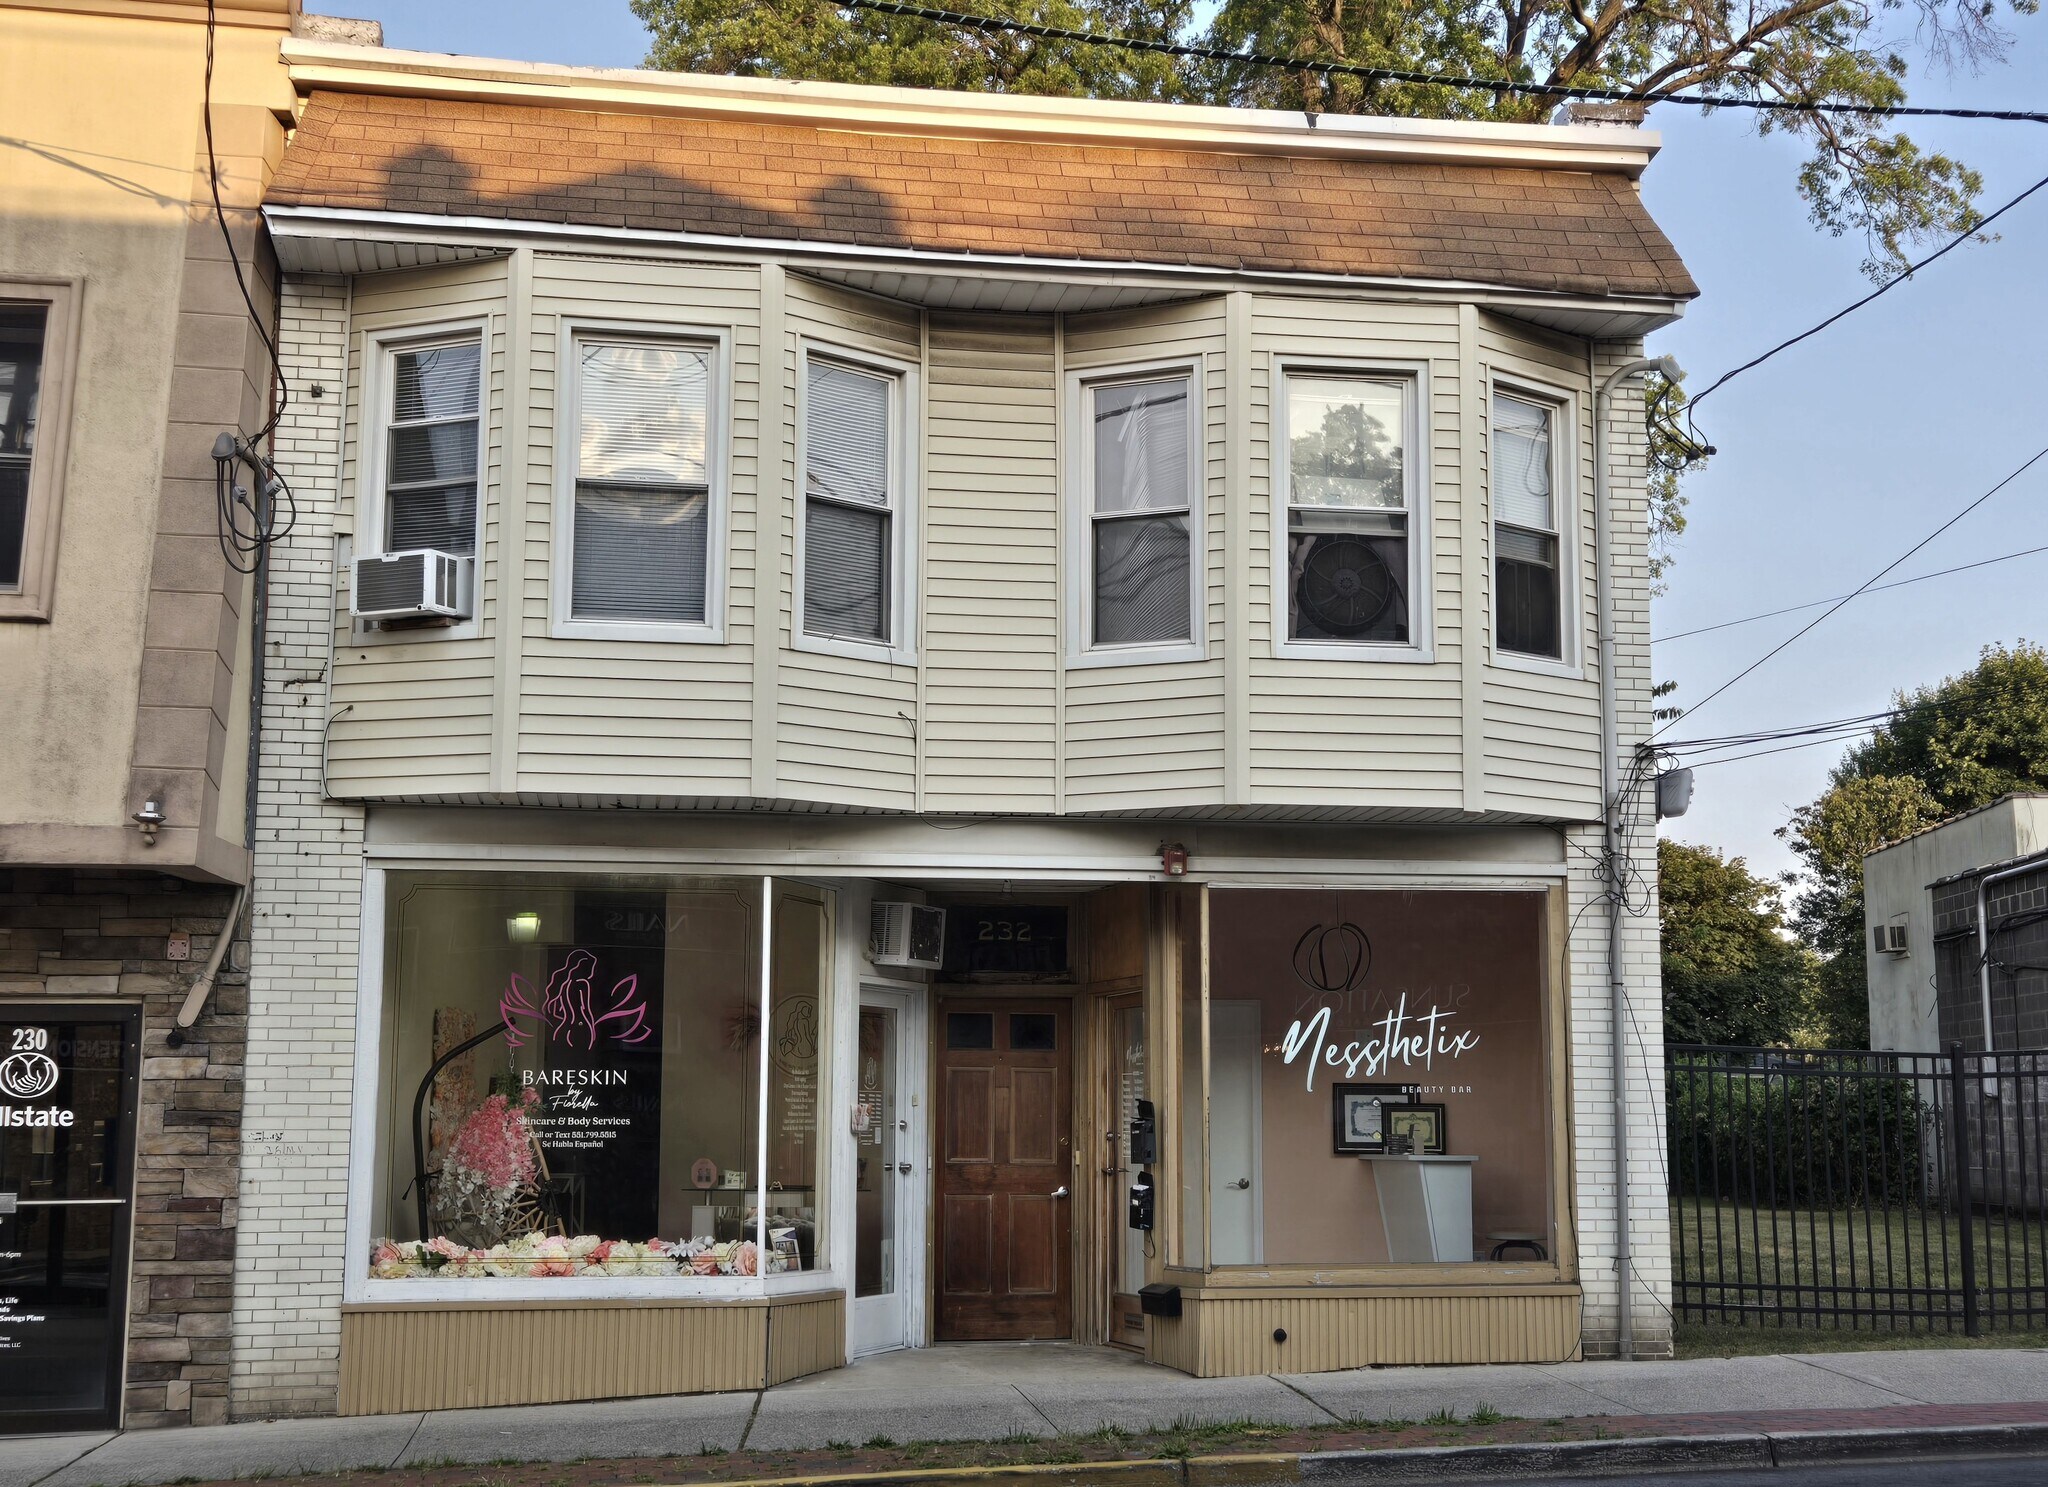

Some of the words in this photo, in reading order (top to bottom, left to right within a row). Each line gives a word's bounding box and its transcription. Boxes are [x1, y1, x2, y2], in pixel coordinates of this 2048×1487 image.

[978, 920, 1032, 941] 232
[11, 1028, 48, 1051] 230
[523, 1070, 627, 1085] BARESKIN
[566, 1083, 584, 1098] by
[1401, 1085, 1444, 1094] BEAUTY
[1451, 1085, 1473, 1094] BAR
[549, 1095, 598, 1111] Fiorella
[0, 1106, 74, 1127] llstate
[516, 1116, 556, 1126] Skincare
[558, 1116, 566, 1126] &
[567, 1116, 591, 1128] Body
[592, 1116, 631, 1126] Services
[554, 1131, 571, 1139] Text
[571, 1131, 617, 1139] 551.799.5515
[542, 1140, 551, 1148] Se
[552, 1140, 574, 1148] Habla
[574, 1140, 604, 1150] Español
